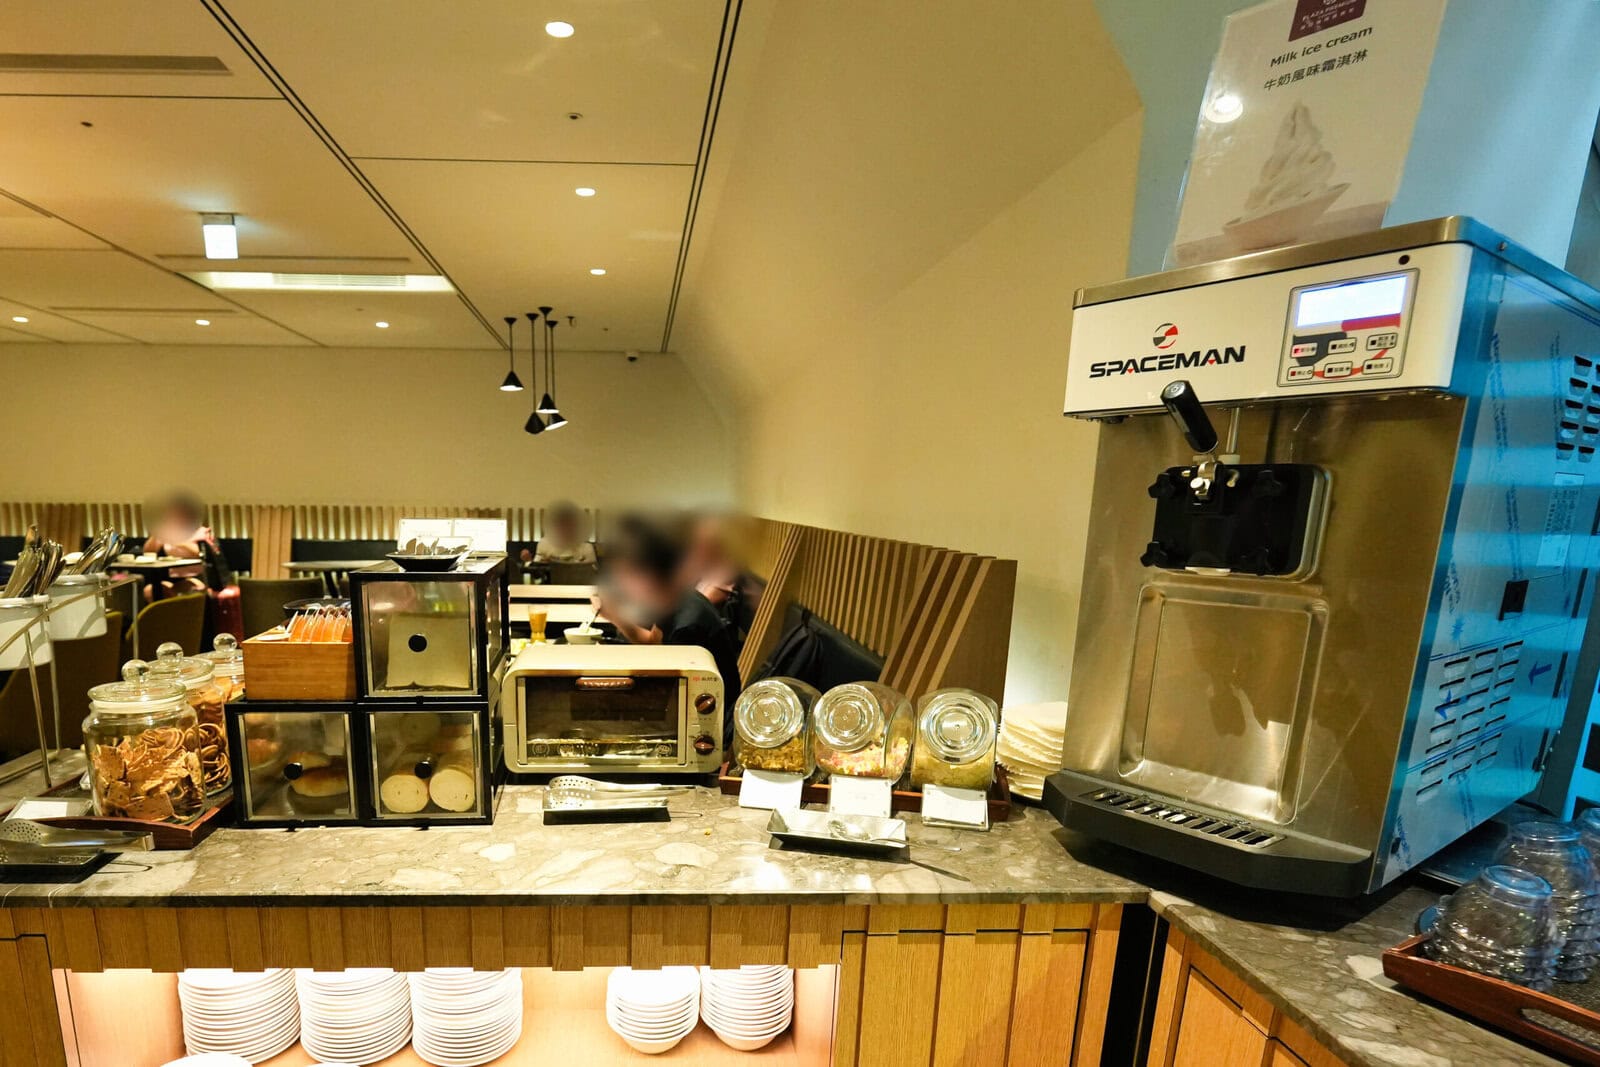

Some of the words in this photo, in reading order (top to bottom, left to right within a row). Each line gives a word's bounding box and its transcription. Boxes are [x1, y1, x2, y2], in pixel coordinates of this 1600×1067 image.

[1270, 51, 1298, 67] Milk
[1302, 44, 1322, 57] ice
[1326, 27, 1373, 48] cream
[1264, 48, 1368, 91] 牛奶風味霜淇淋
[1089, 345, 1246, 378] SPACEMAN
